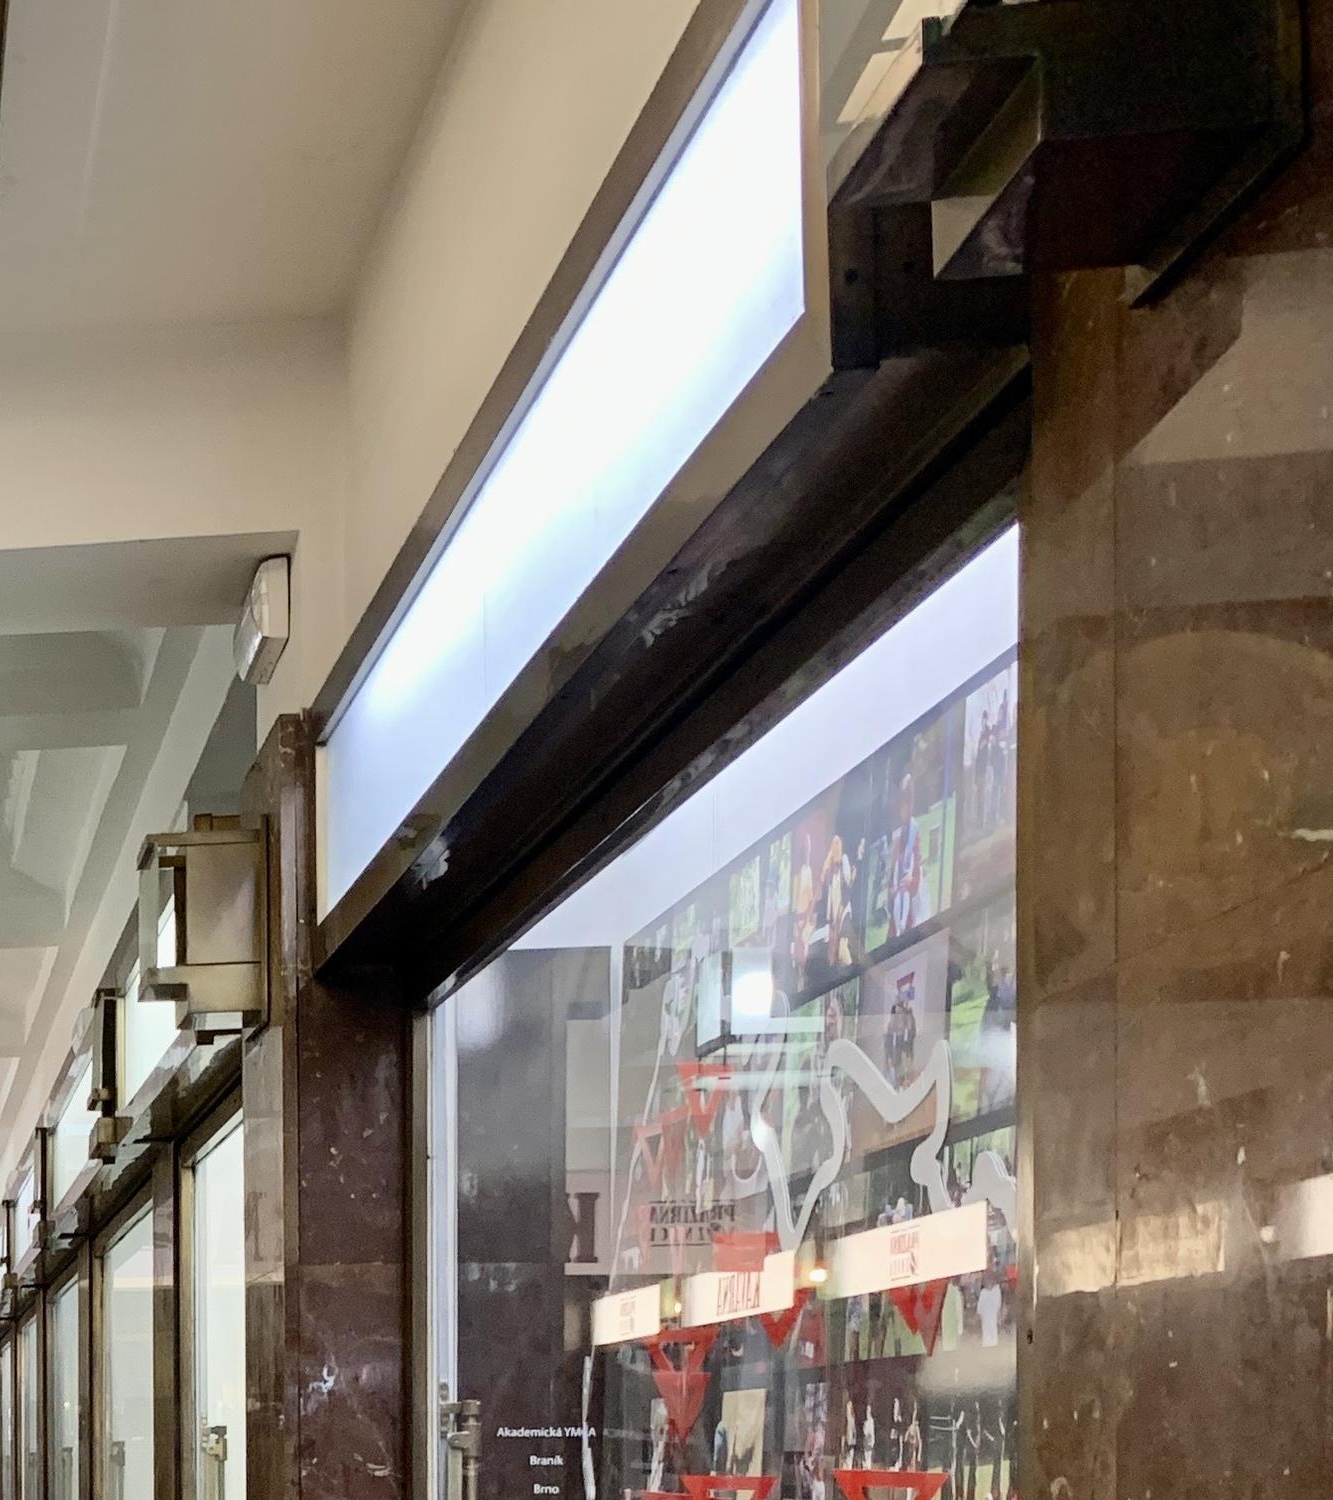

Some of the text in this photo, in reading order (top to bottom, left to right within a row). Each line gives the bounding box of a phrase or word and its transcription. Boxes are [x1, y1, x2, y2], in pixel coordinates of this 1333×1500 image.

[496, 1427, 596, 1438] Akademická YMA
[529, 1455, 564, 1466] Braník
[533, 1484, 560, 1494] Brno
